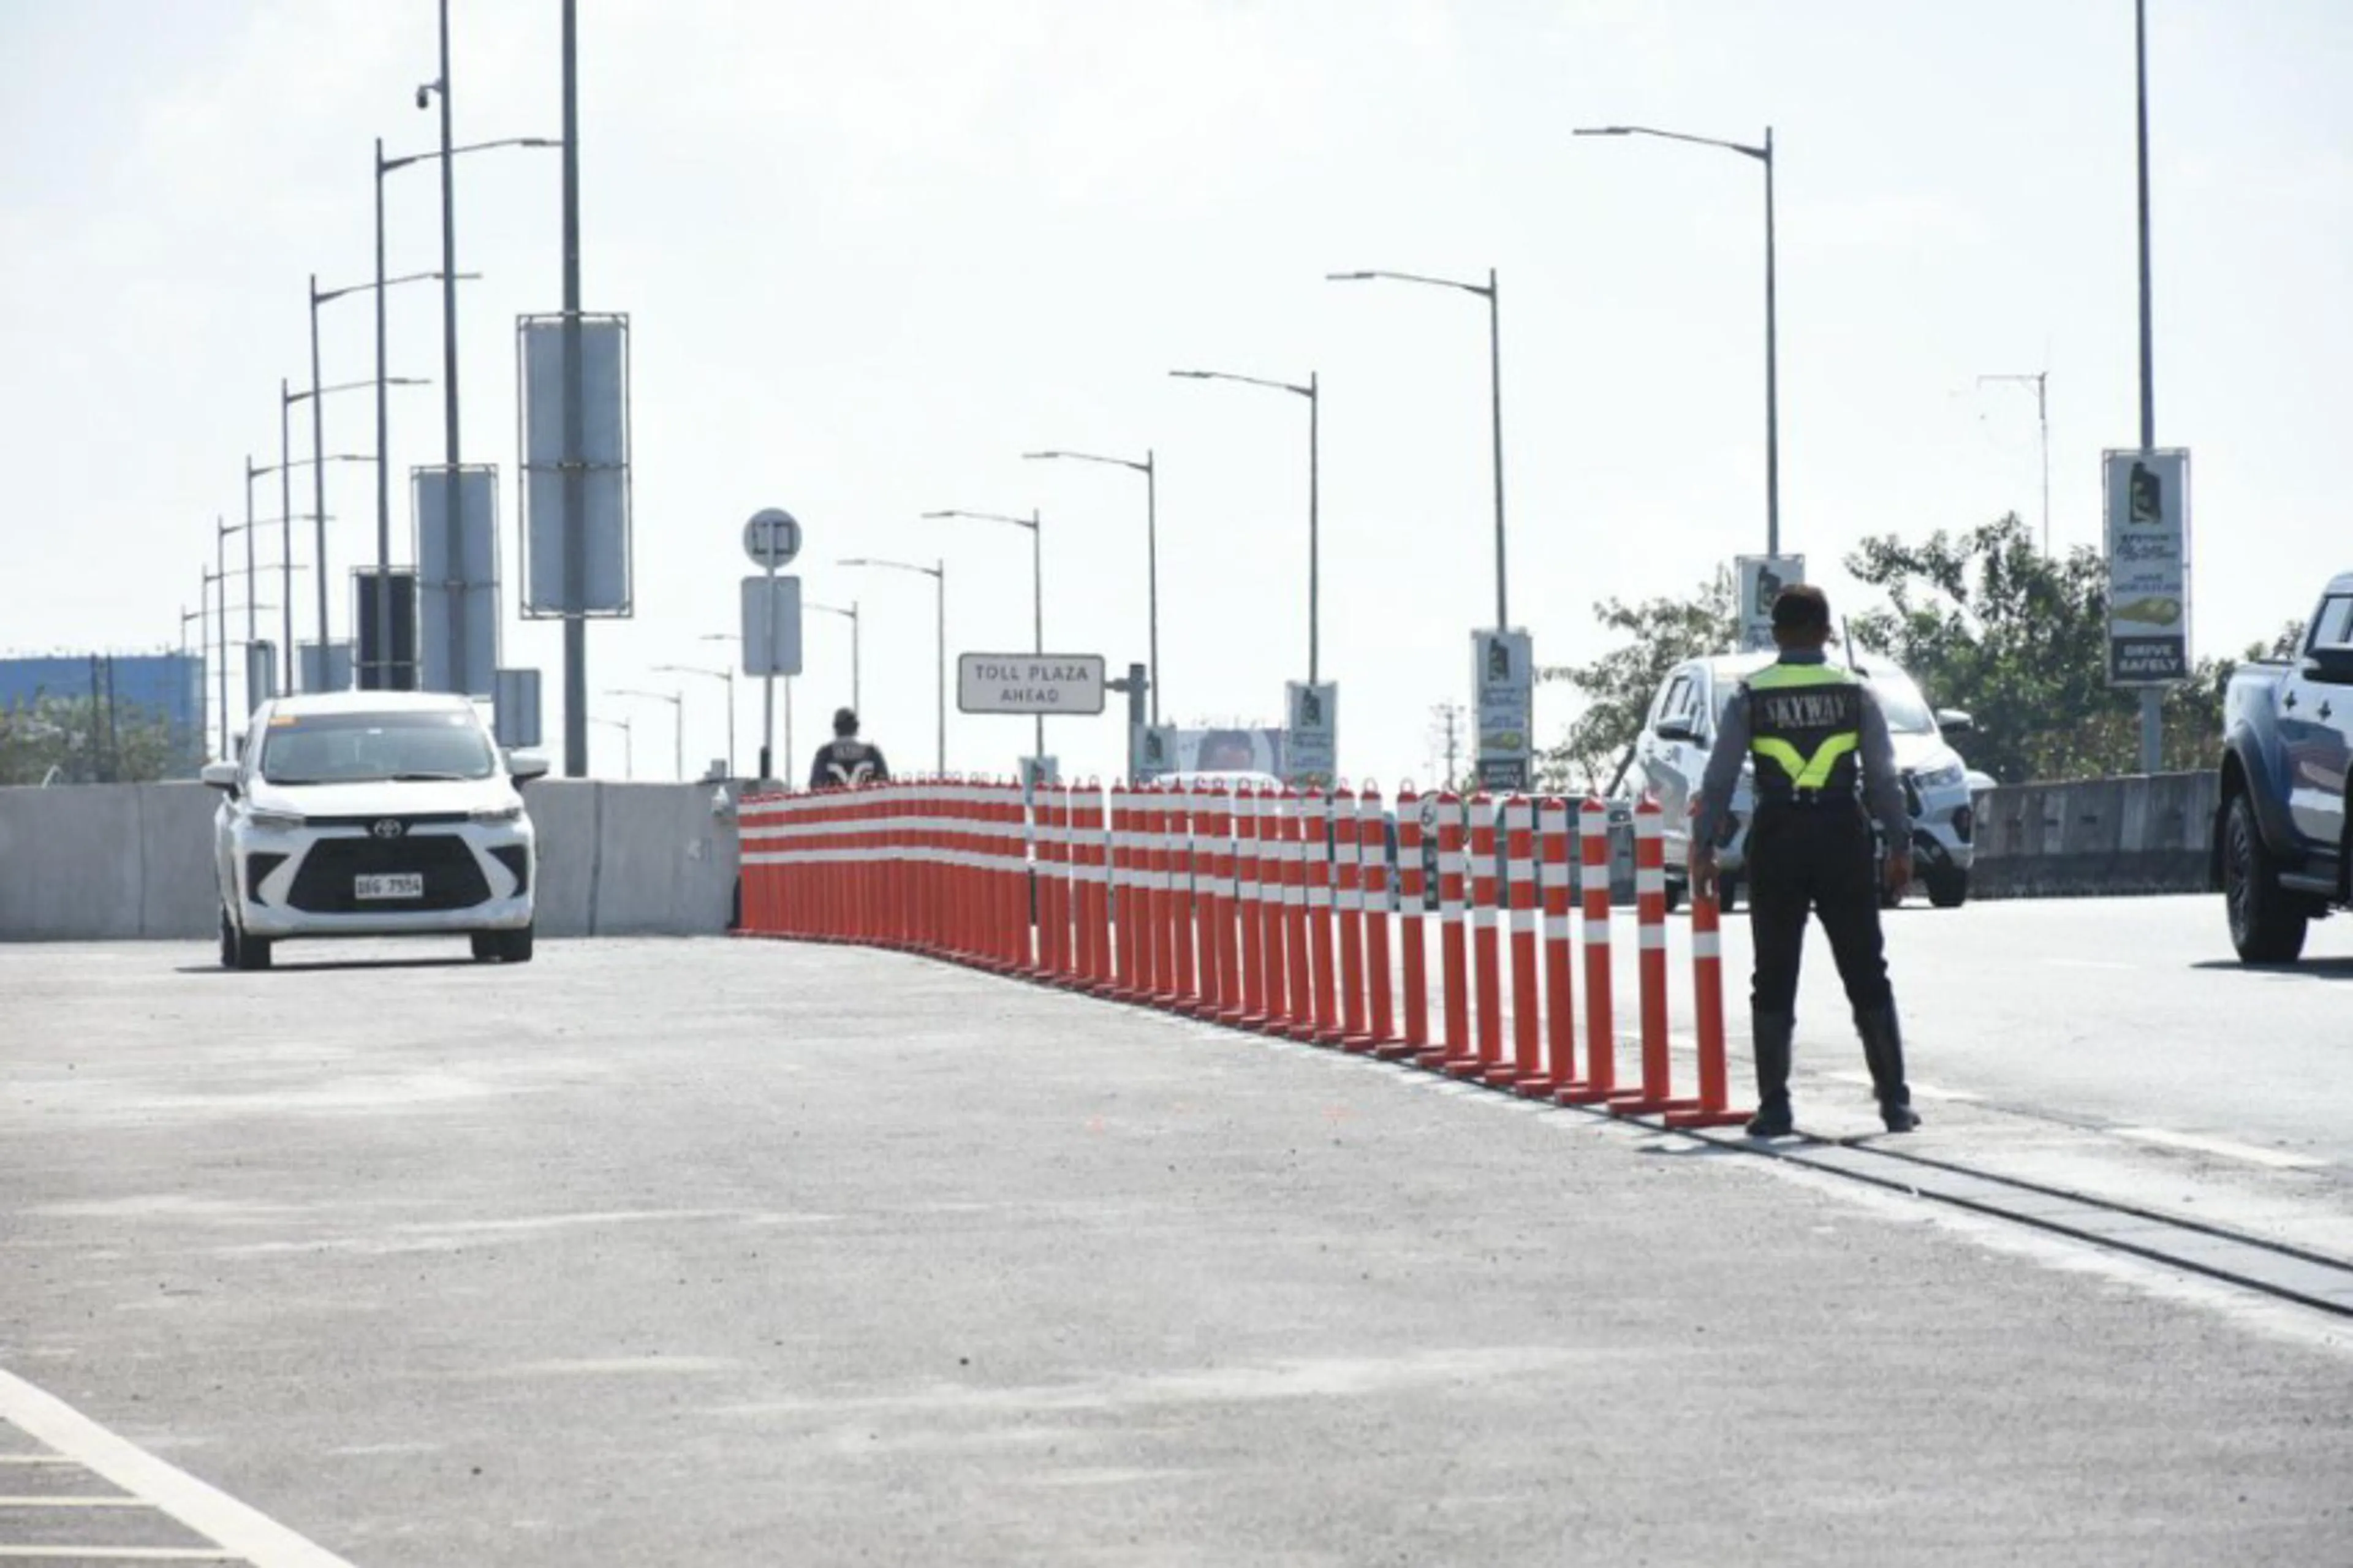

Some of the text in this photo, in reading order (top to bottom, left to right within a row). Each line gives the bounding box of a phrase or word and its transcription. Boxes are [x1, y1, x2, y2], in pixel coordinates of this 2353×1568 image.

[975, 664, 1089, 681] TOLL PLAZA
[1000, 688, 1059, 703] AHEAD
[1765, 694, 1849, 721] SKYWAY
